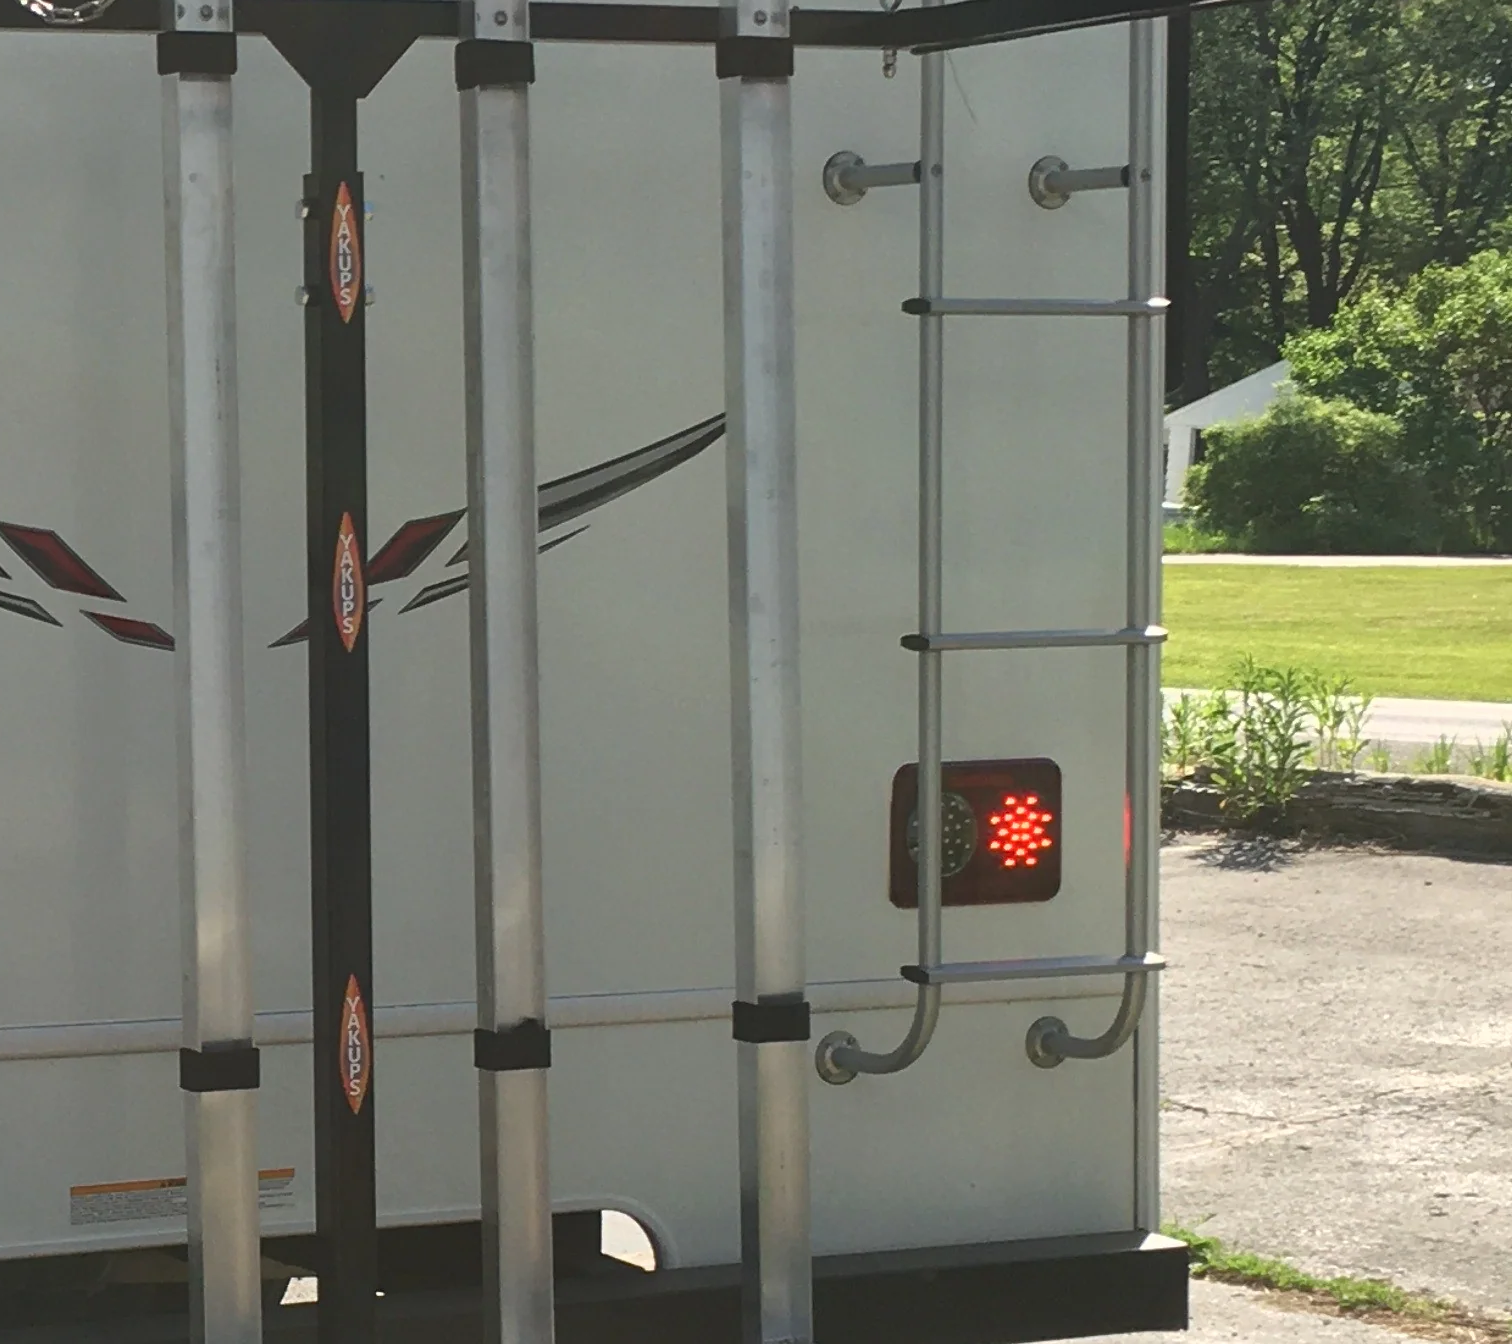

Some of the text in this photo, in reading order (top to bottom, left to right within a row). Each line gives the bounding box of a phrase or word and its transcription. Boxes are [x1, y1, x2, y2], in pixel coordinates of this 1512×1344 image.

[337, 203, 352, 305] YAKUPS
[339, 533, 354, 634] YAKUPS
[346, 996, 361, 1096] YAKUPS
